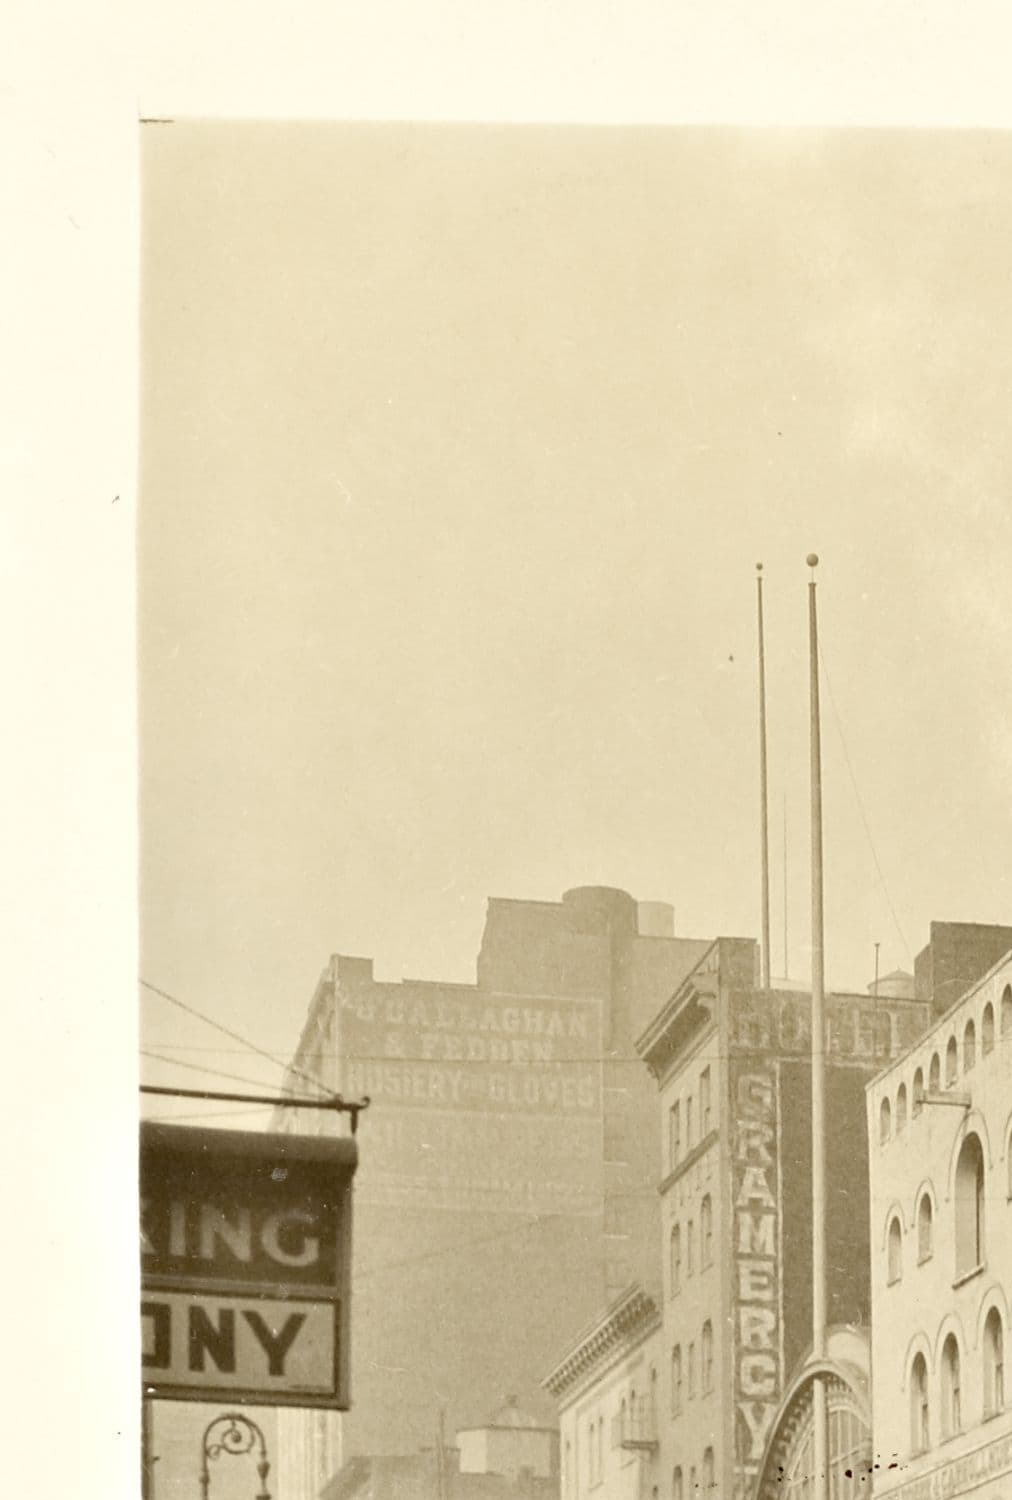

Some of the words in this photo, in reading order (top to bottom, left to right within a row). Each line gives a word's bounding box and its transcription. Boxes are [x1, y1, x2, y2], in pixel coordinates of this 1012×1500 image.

[346, 1062, 462, 1102] HOSIERY
[487, 1071, 595, 1108] GLOVES
[736, 1076, 777, 1460] GRAMERCY
